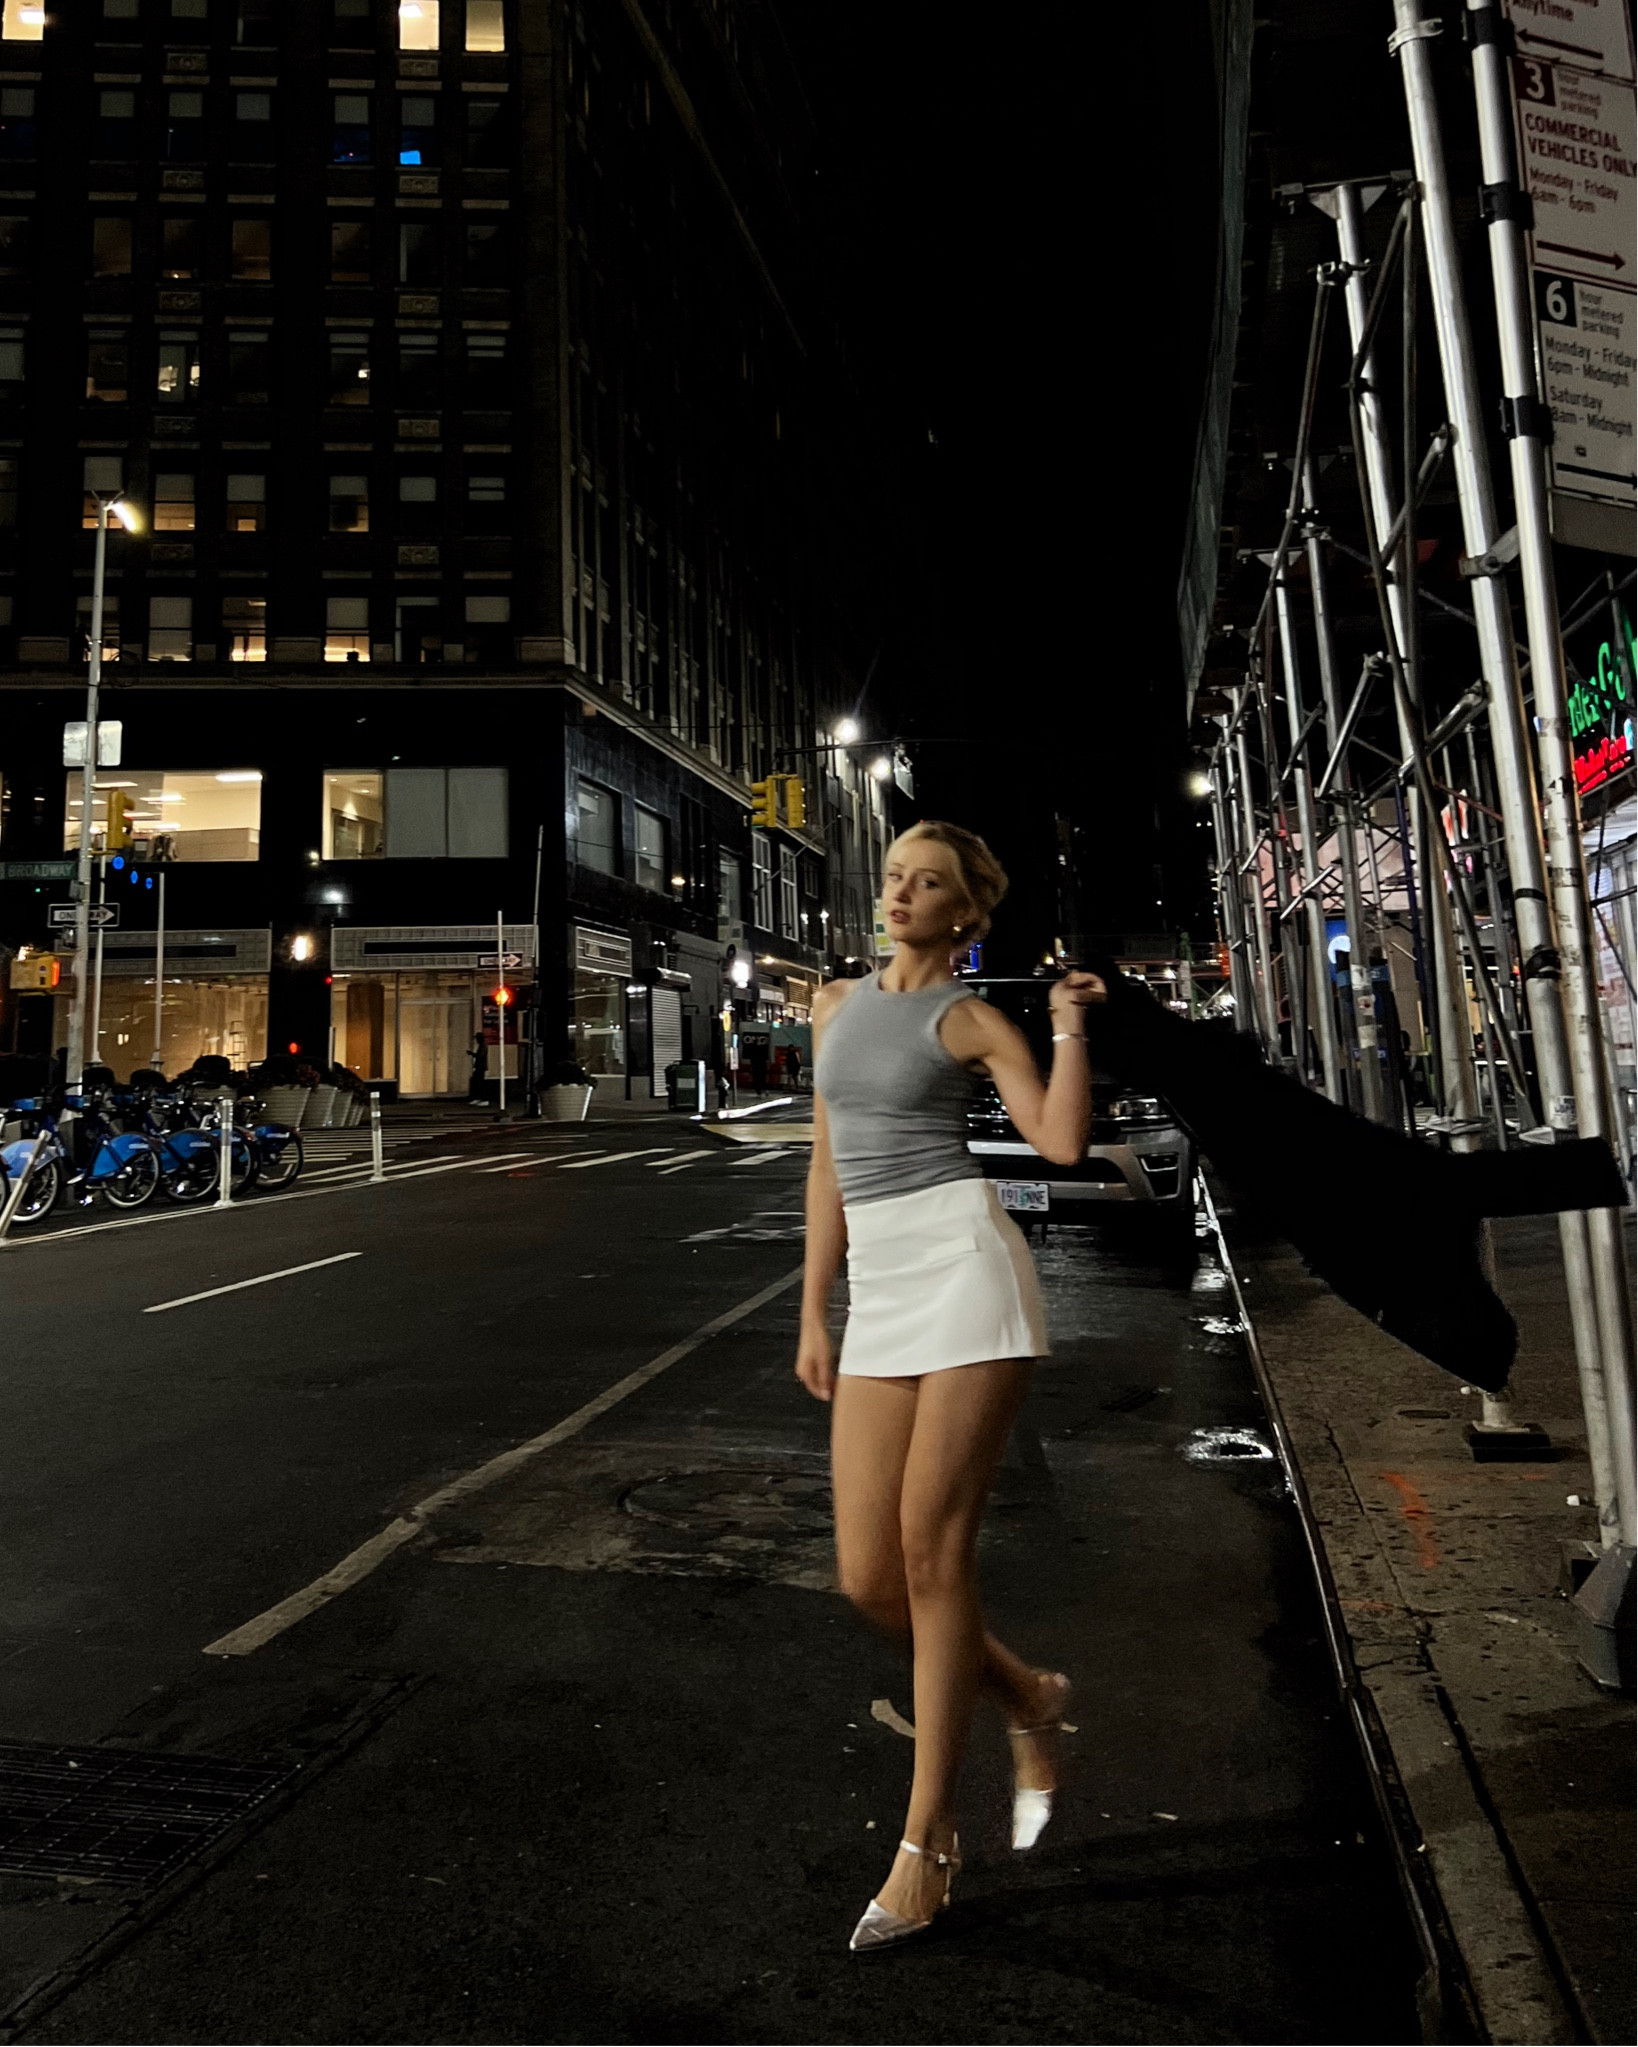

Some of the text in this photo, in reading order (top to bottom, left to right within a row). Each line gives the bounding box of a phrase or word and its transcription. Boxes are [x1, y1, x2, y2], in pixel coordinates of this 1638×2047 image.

[1524, 61, 1546, 100] 3
[1525, 113, 1622, 152] COMMERCIAL
[1527, 136, 1598, 169] VEHICLES
[1529, 167, 1573, 193] Monday
[1584, 179, 1619, 203] Friday
[1531, 186, 1558, 205] 6am
[1568, 194, 1596, 213] 6pm
[1546, 280, 1567, 321] 6
[1581, 306, 1624, 325] metered
[1582, 320, 1620, 340] parking
[1545, 335, 1591, 362] Monday
[1547, 356, 1573, 376] 6pm
[1583, 363, 1630, 388] Midnight
[1549, 385, 1603, 413] Saturday
[1551, 405, 1577, 425] 8am
[1586, 413, 1632, 438] Midnight
[7, 864, 74, 878] BROADWAY
